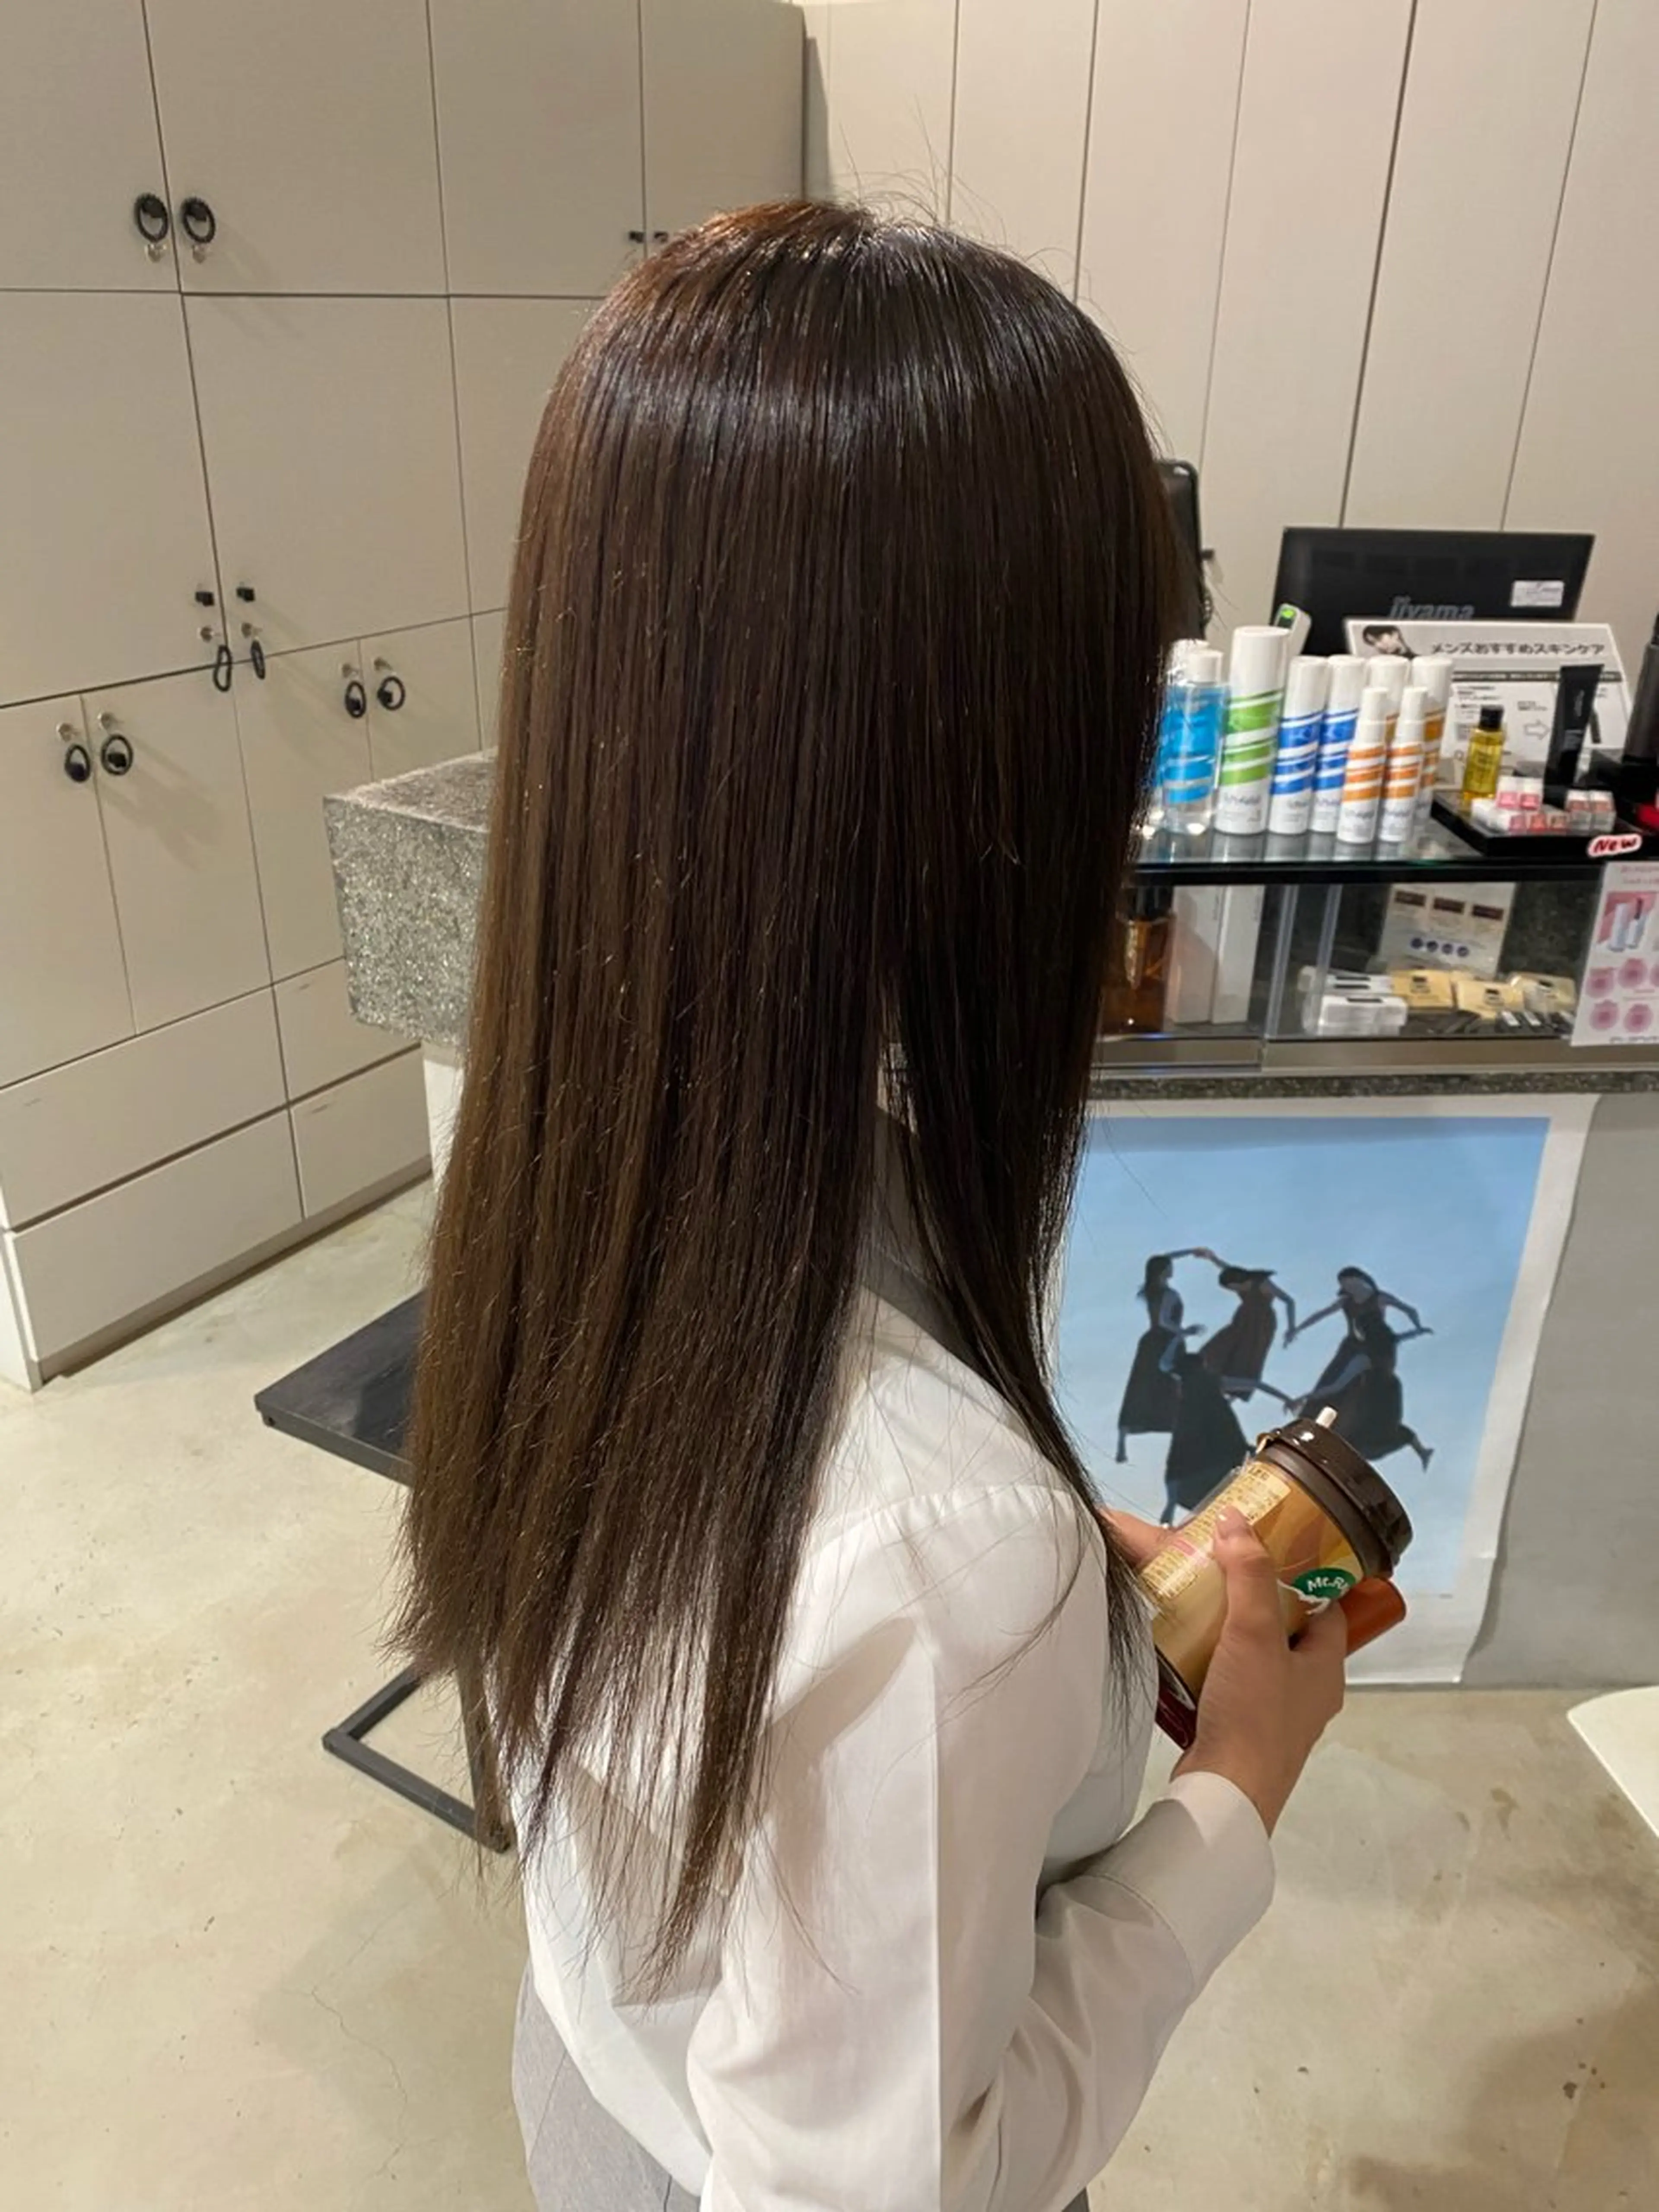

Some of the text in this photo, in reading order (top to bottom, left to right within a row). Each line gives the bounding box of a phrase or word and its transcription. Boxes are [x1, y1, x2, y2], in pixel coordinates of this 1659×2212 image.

[1390, 596, 1475, 620] iiyama
[1431, 642, 1605, 655] メンズおすすめスキンケア
[1593, 838, 1637, 853] New
